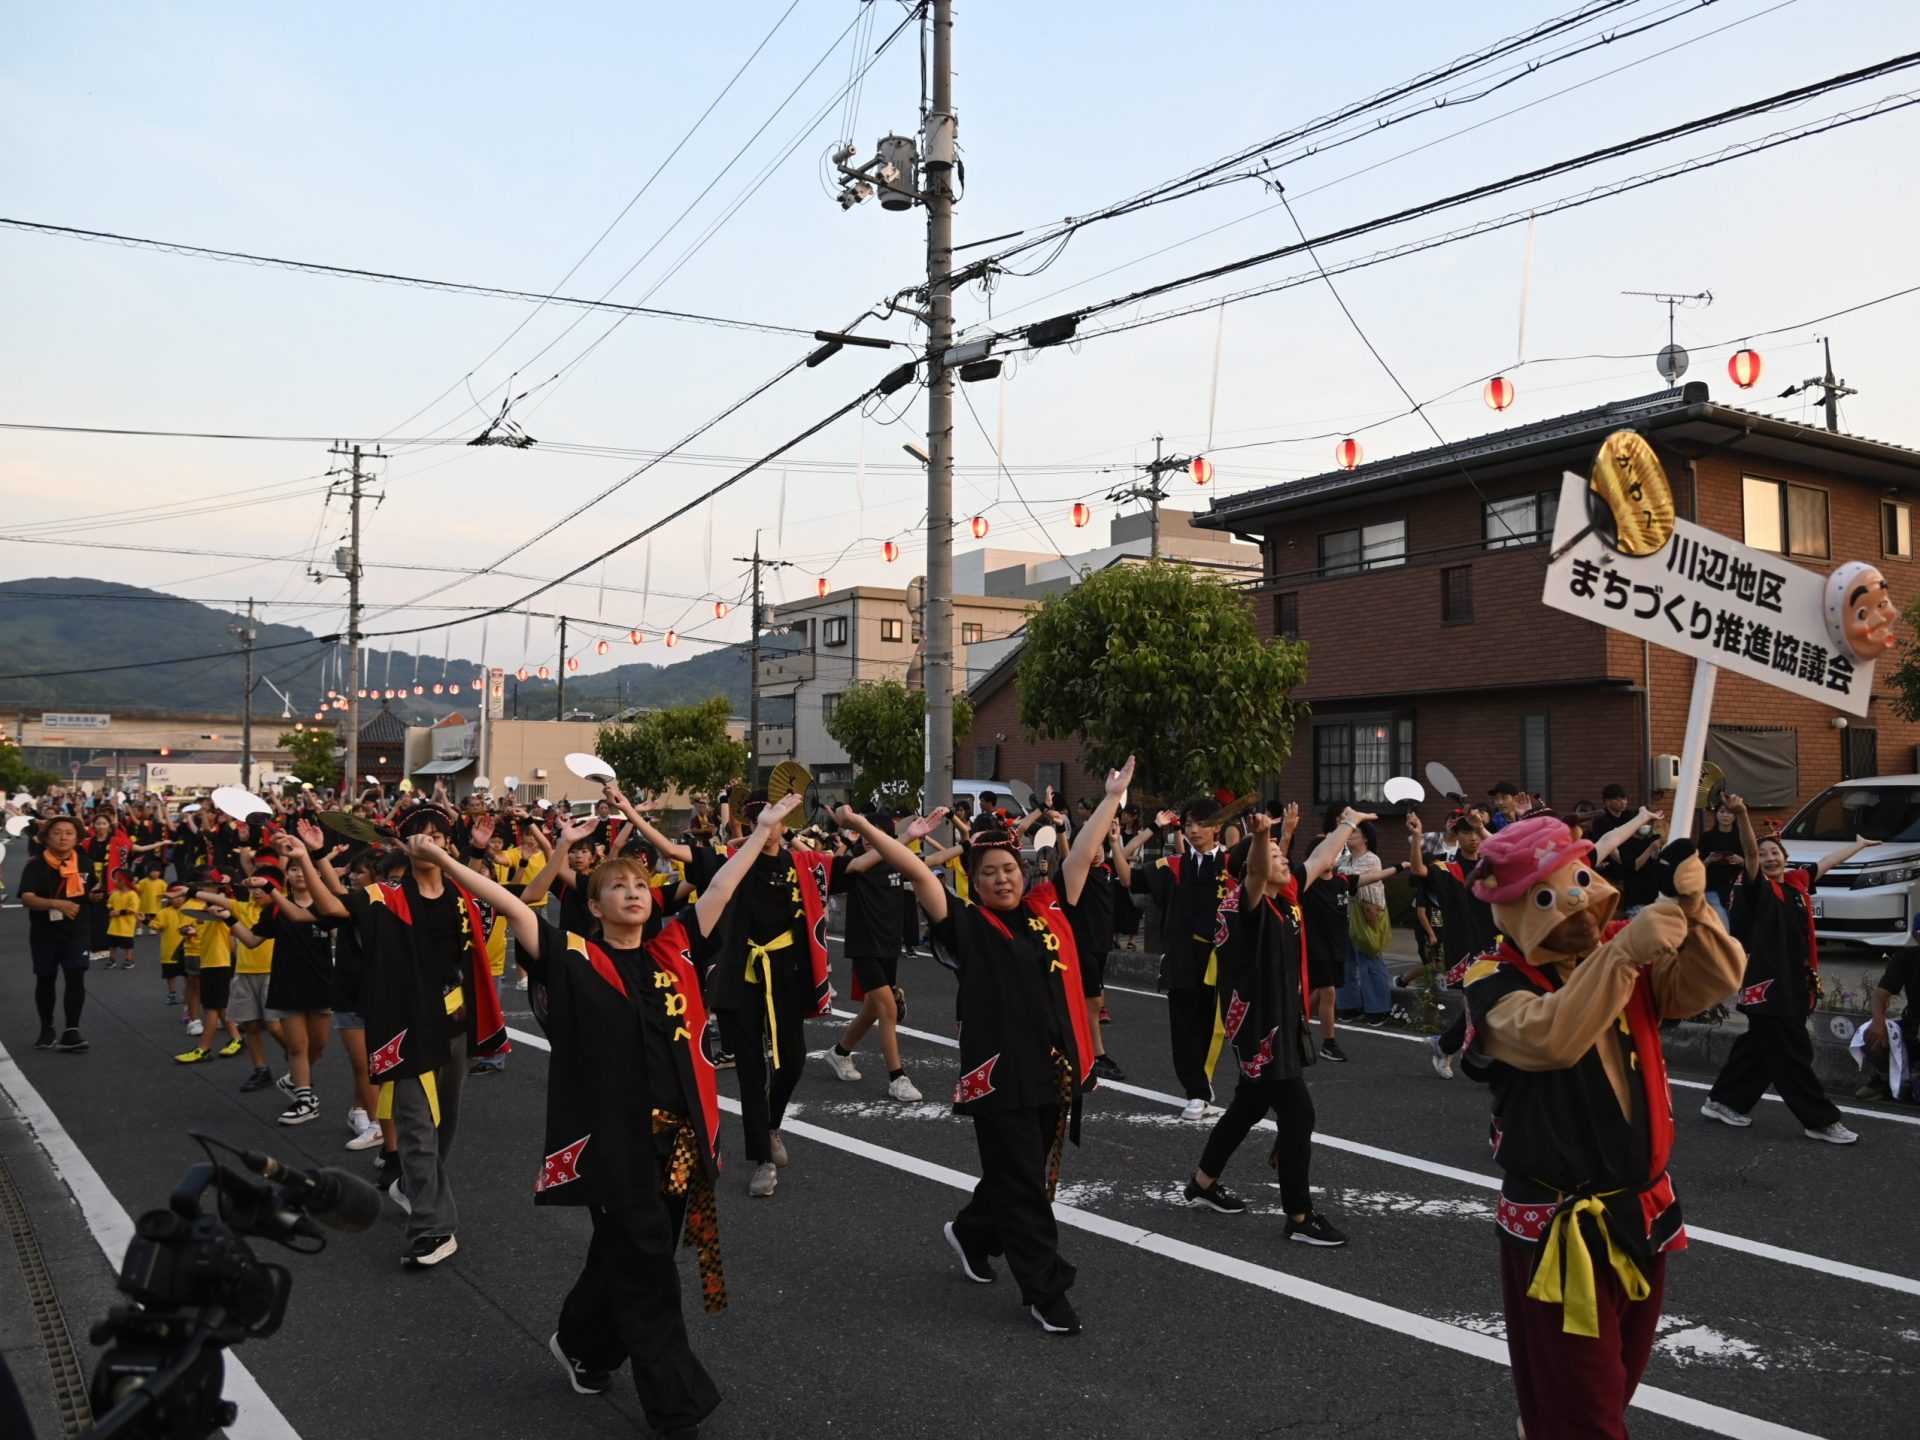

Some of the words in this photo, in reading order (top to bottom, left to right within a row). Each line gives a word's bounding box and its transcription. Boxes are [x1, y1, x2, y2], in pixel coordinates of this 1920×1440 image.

[1569, 558, 1855, 695] まちづくり推進協議会
[1666, 533, 1787, 614] 川辺地区
